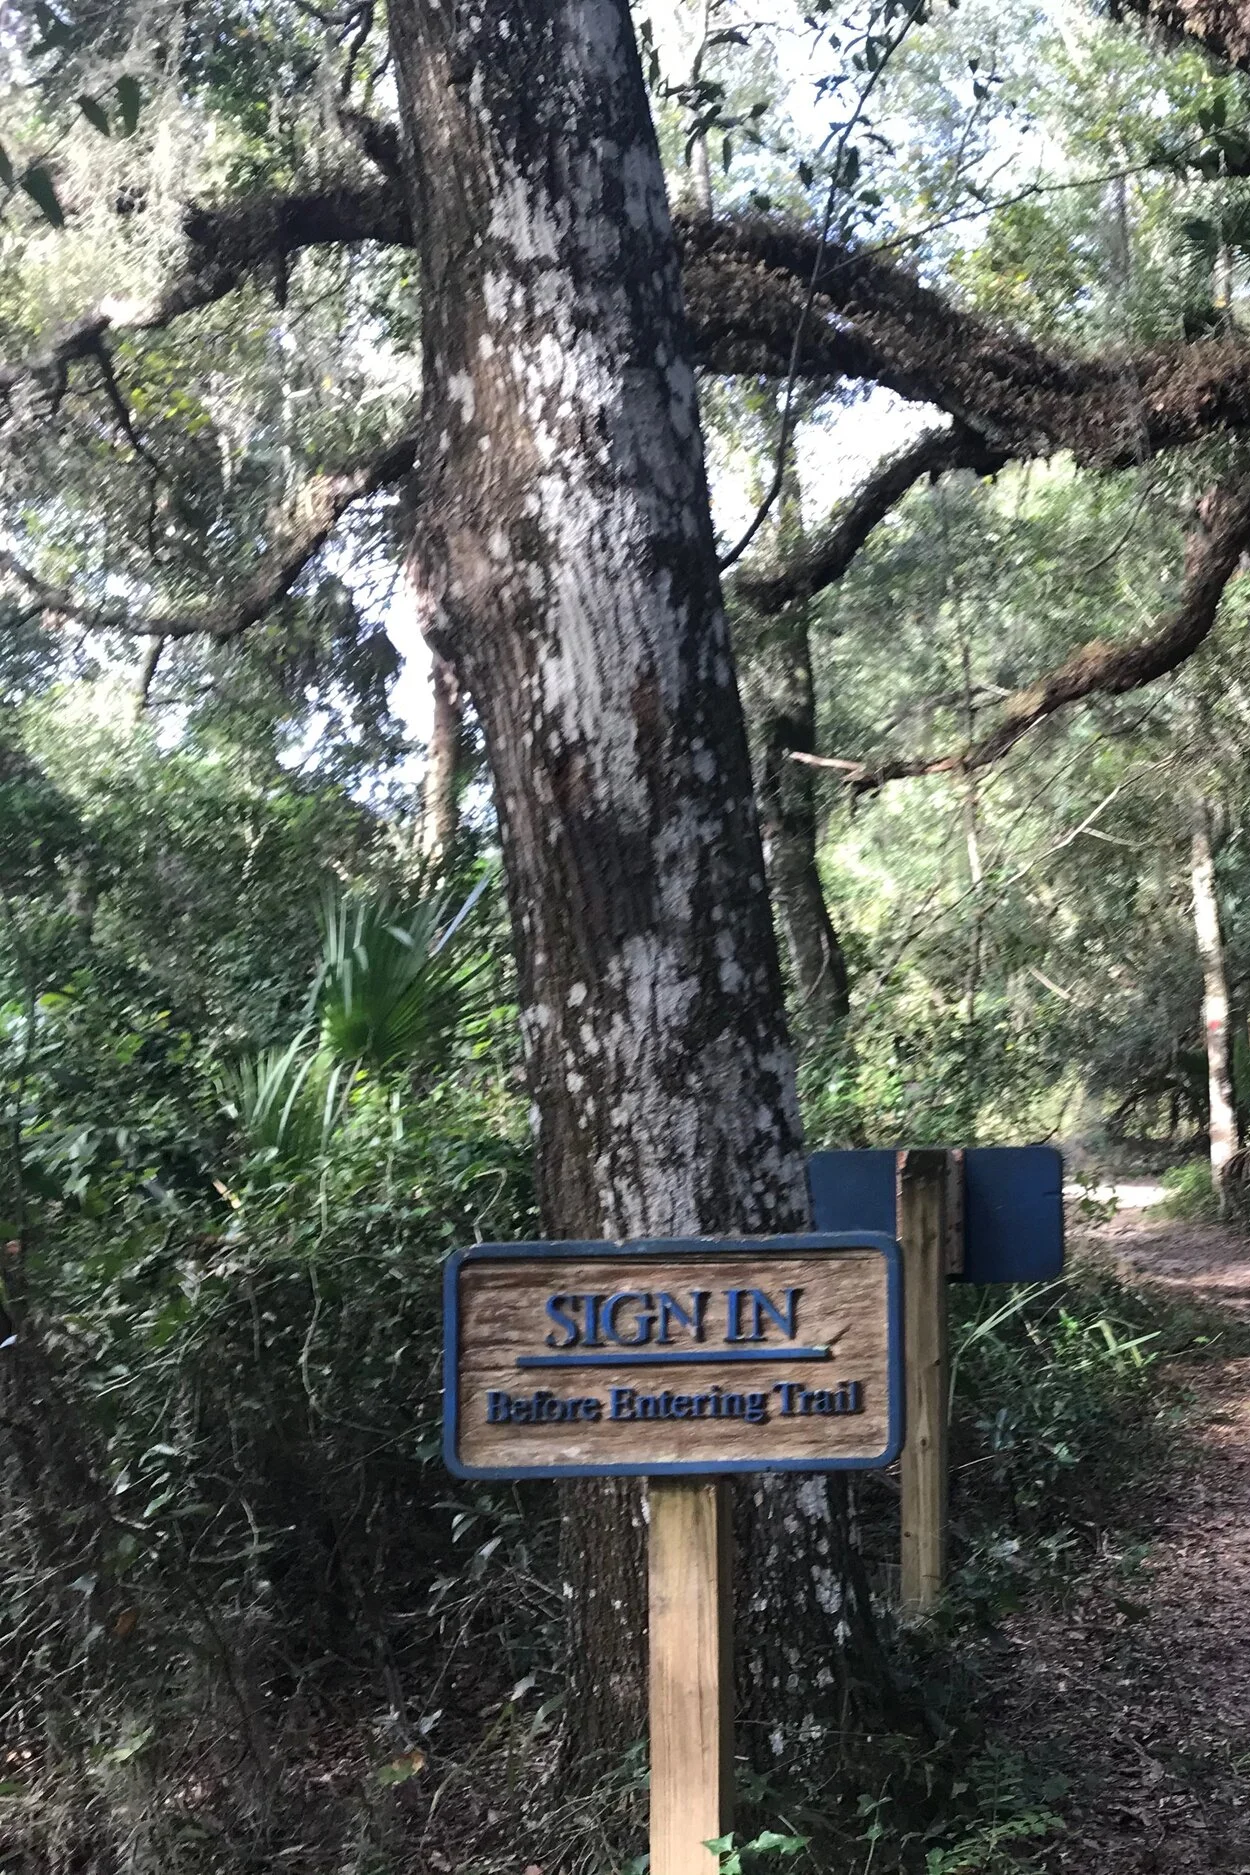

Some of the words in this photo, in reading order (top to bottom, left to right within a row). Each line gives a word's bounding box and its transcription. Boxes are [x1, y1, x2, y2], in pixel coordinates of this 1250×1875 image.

[545, 1288, 709, 1347] SIGN
[722, 1287, 803, 1342] IN
[486, 1389, 600, 1424] Before
[609, 1385, 767, 1423] Entering
[773, 1379, 860, 1416] Trail
